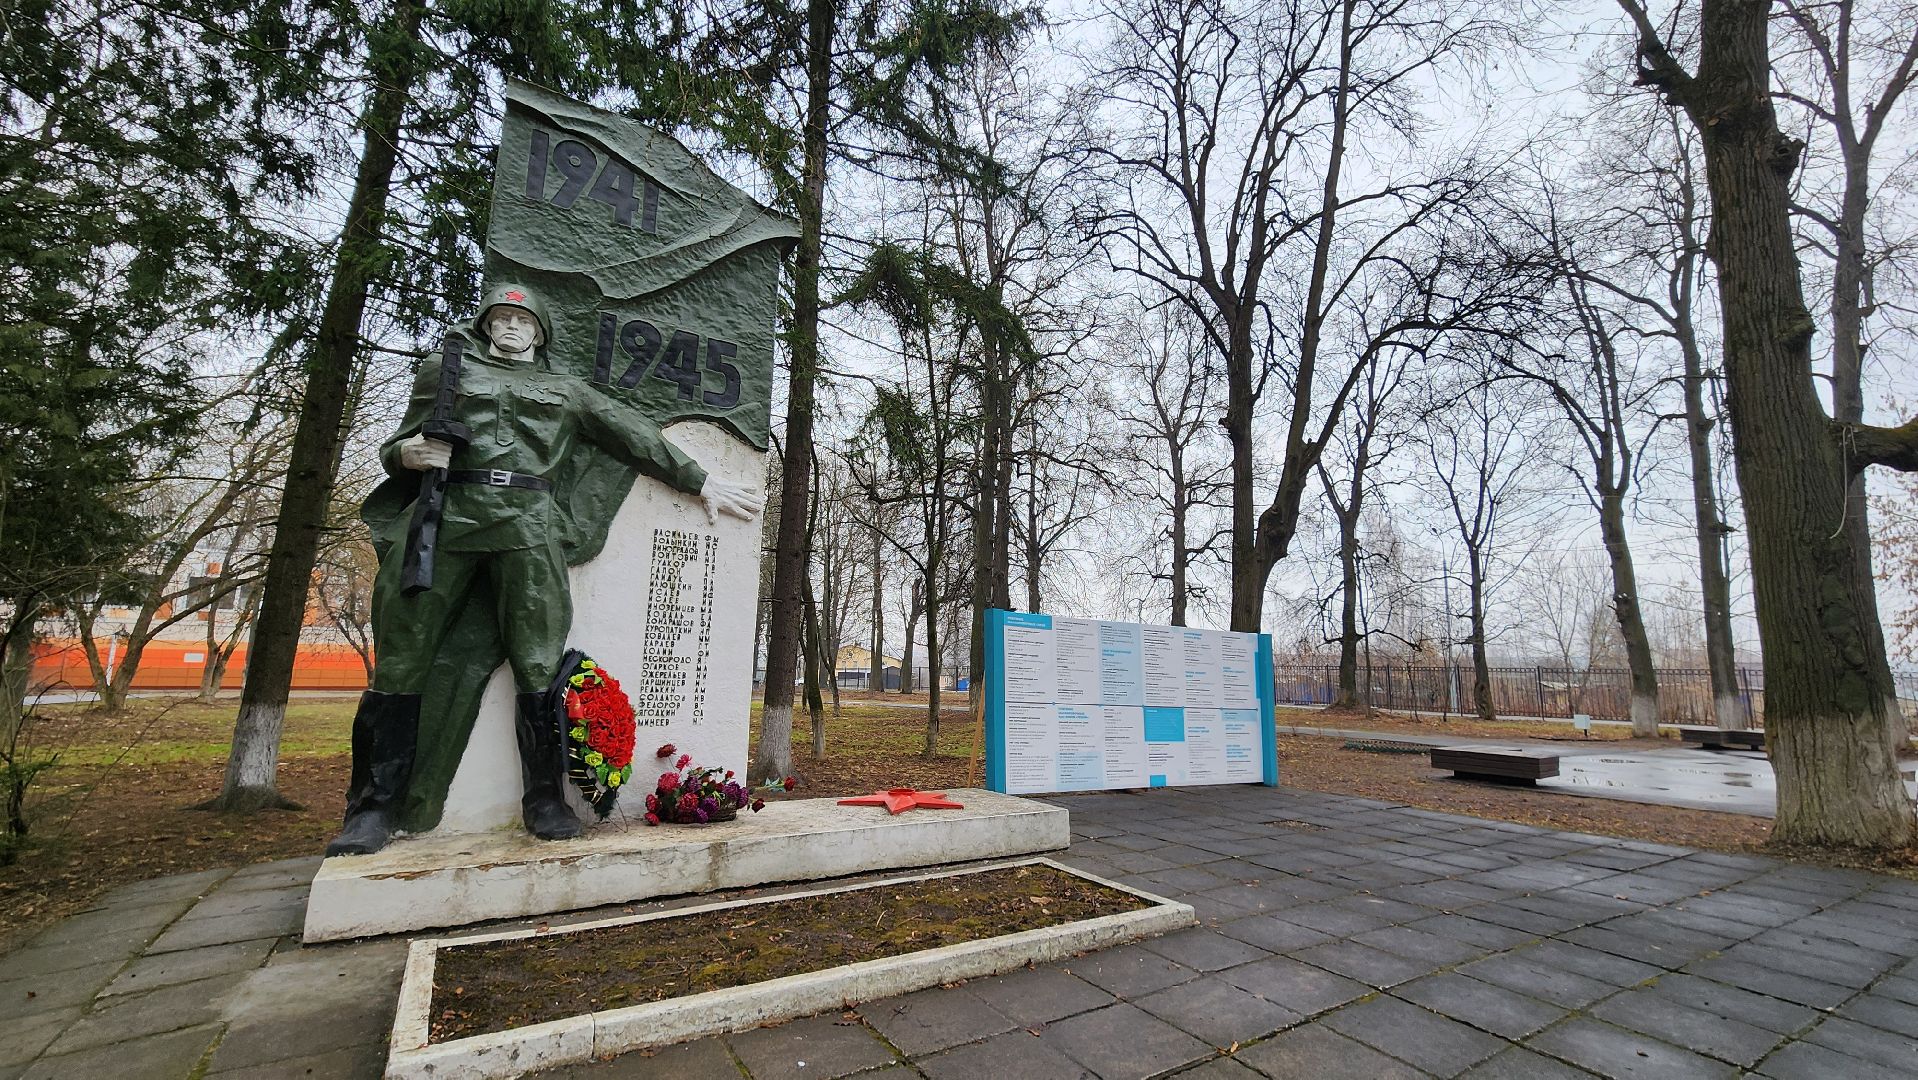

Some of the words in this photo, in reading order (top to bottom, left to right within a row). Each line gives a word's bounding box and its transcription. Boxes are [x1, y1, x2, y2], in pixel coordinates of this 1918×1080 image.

[526, 129, 659, 234] 1941
[592, 312, 742, 408] 1945
[653, 544, 698, 554] ВИНОГРАДОВ
[651, 566, 680, 574] ГАПОН
[647, 610, 684, 619] КОВАЛЬ
[646, 624, 692, 633] КУРОПАТКИН
[643, 647, 672, 655] КОЛИН
[641, 670, 686, 679] ОЖЕРЕЛЬЕВ
[639, 701, 680, 709] ФЕДОРОВ
